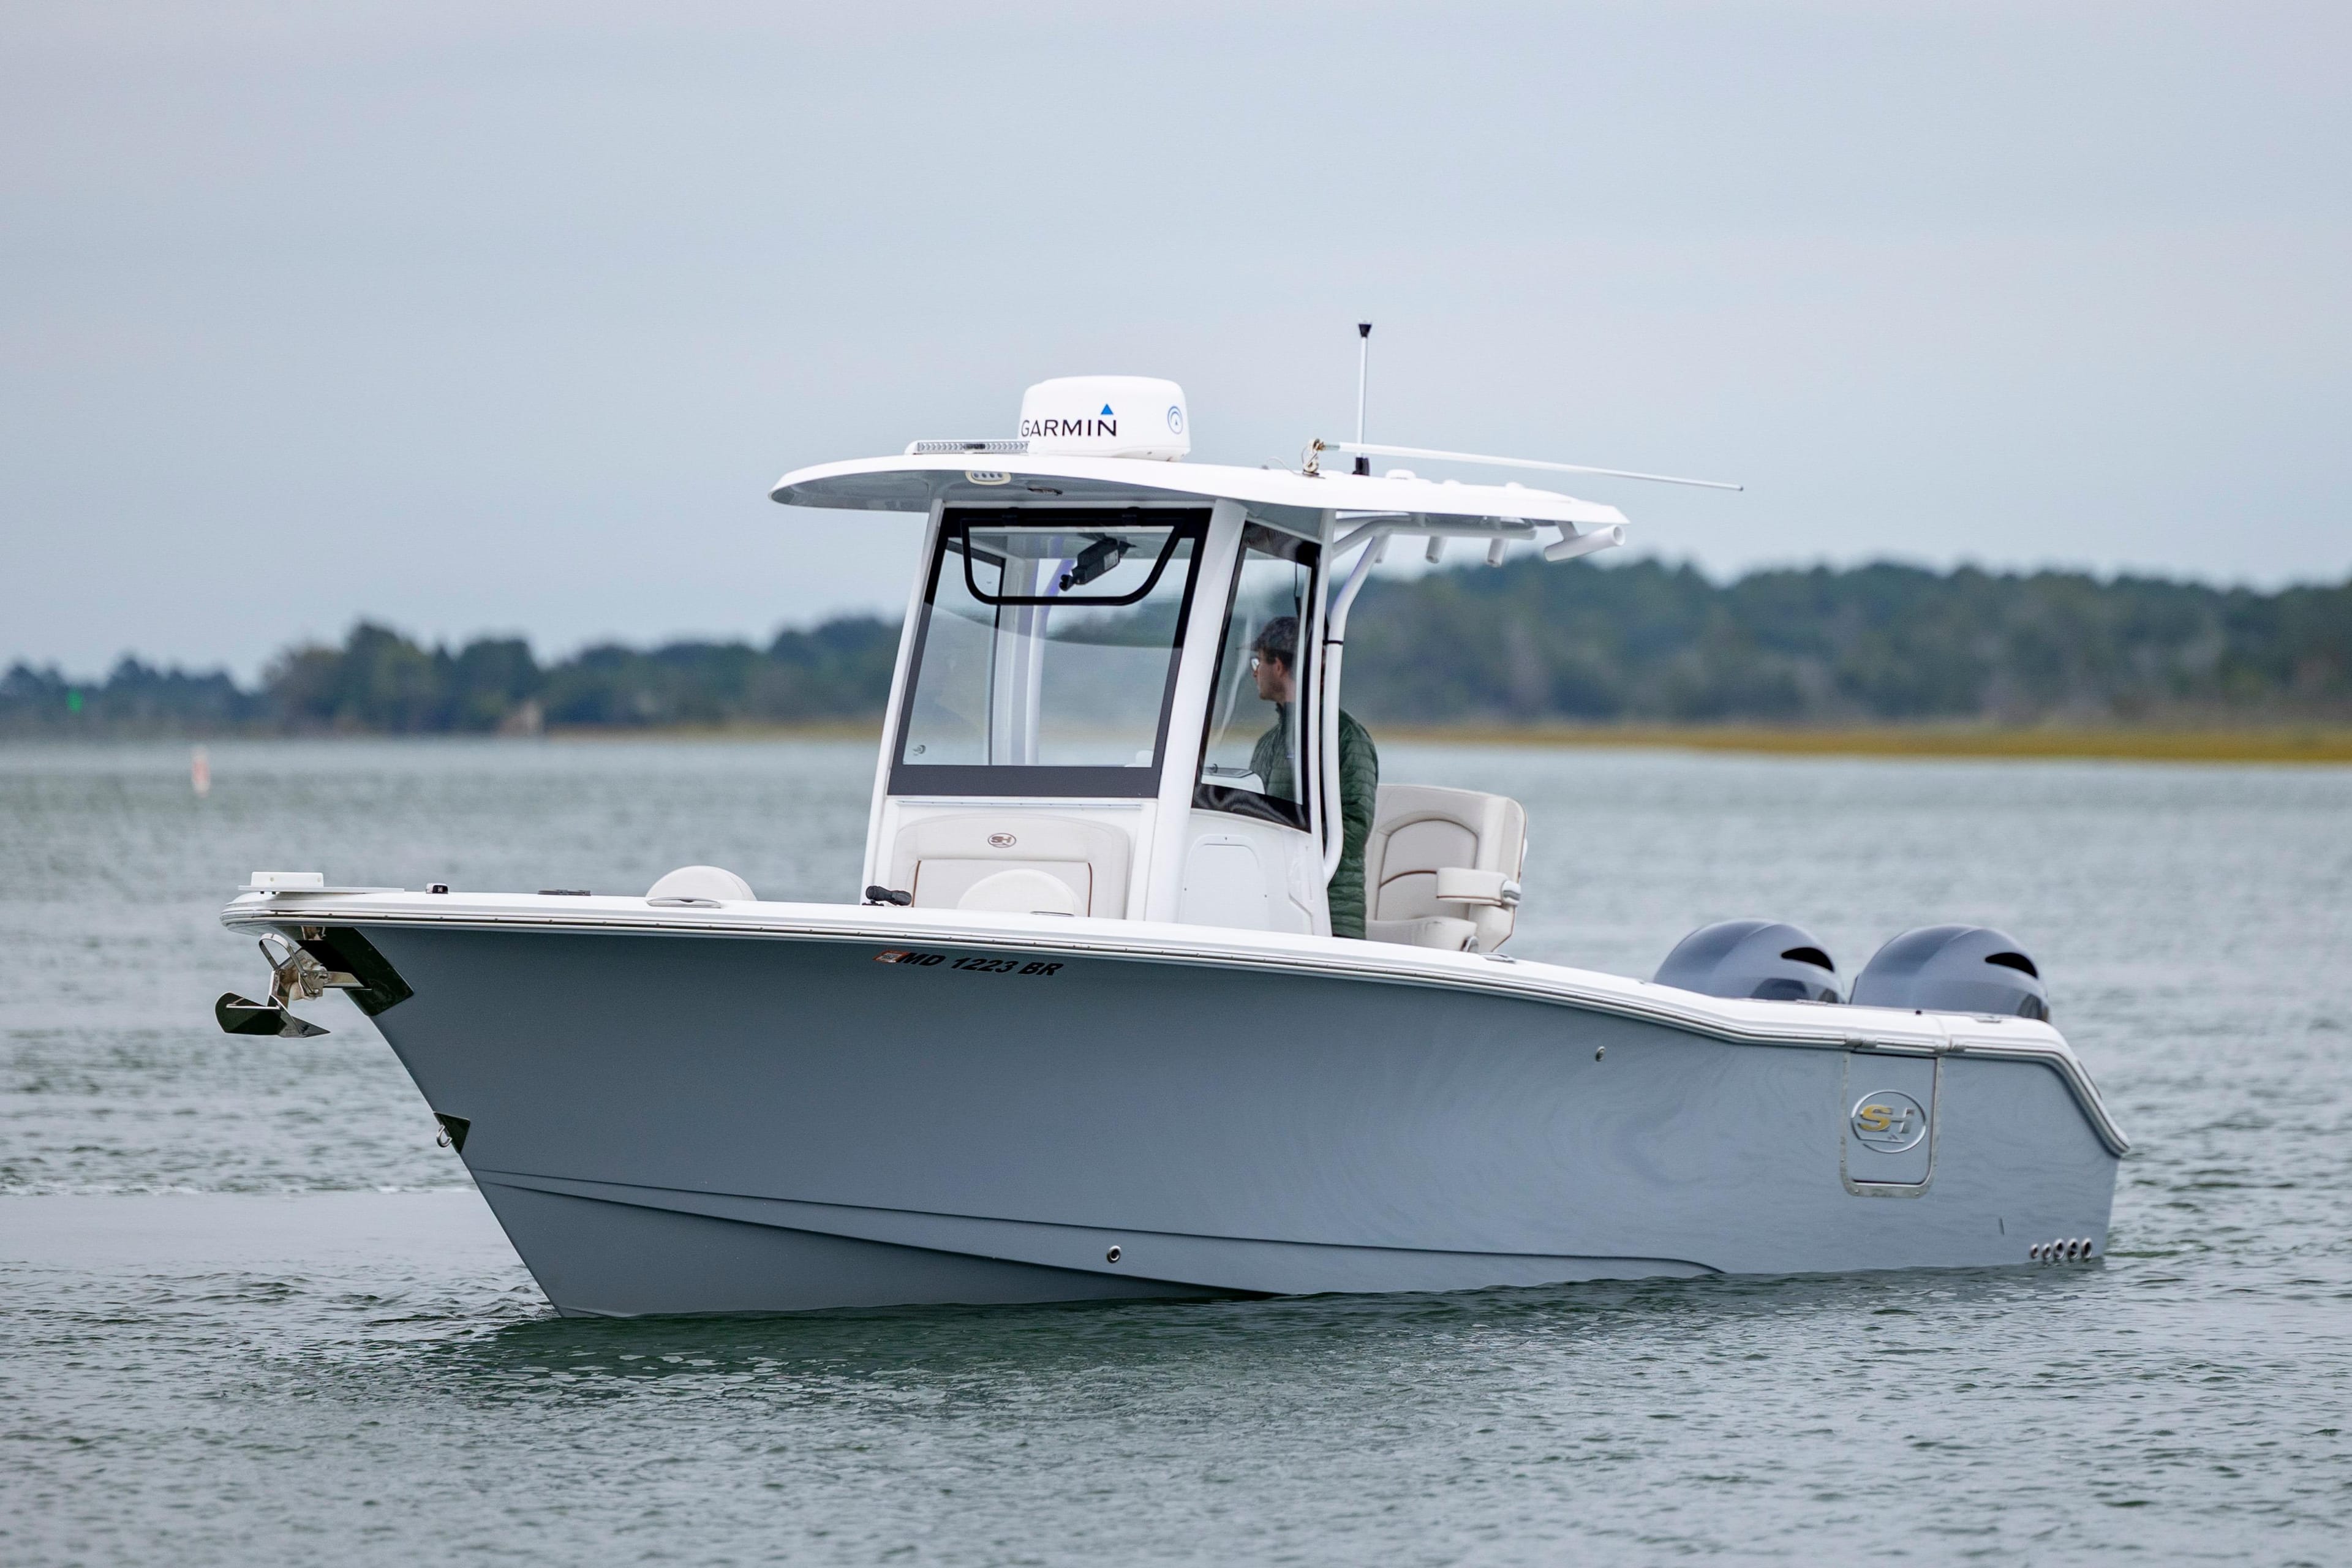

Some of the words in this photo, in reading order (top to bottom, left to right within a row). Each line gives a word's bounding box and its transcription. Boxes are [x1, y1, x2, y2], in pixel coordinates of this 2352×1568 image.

[1021, 420, 1117, 436] GARMIN
[897, 952, 946, 966] MD
[951, 957, 1019, 973] 1223
[1017, 962, 1064, 976] BR
